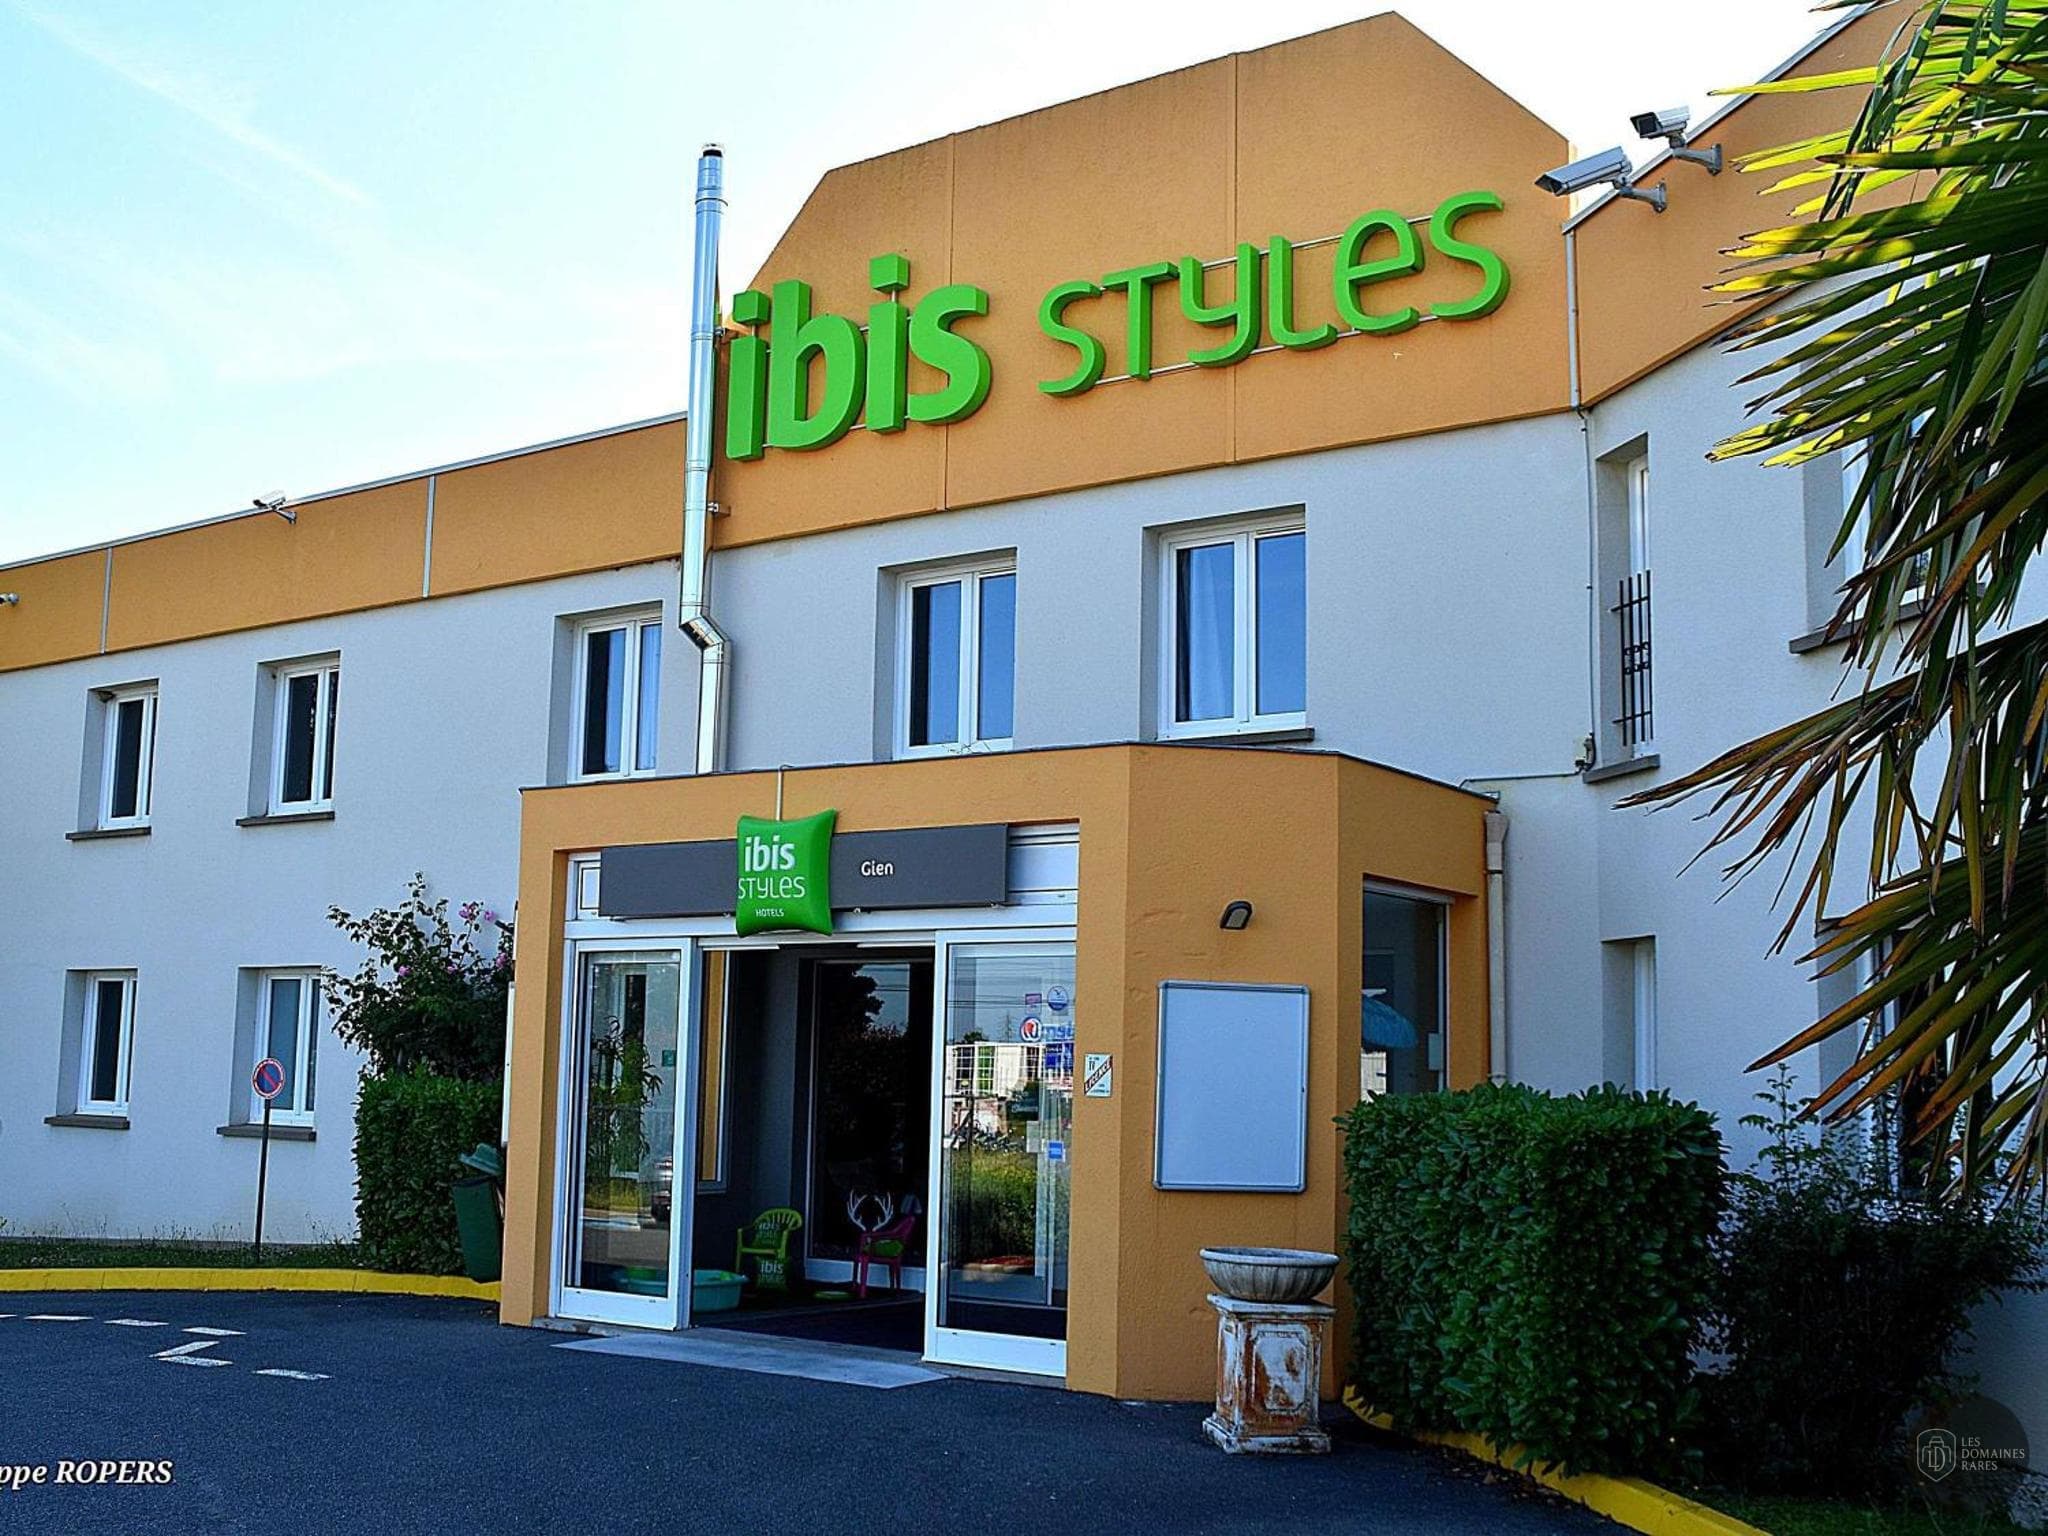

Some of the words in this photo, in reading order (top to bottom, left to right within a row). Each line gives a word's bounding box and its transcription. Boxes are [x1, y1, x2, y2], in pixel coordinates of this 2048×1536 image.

[725, 254, 992, 460] ibis
[744, 835, 795, 872] ibis
[860, 860, 894, 877] Gien
[755, 908, 785, 917] HOTELS
[760, 1259, 785, 1274] ibis
